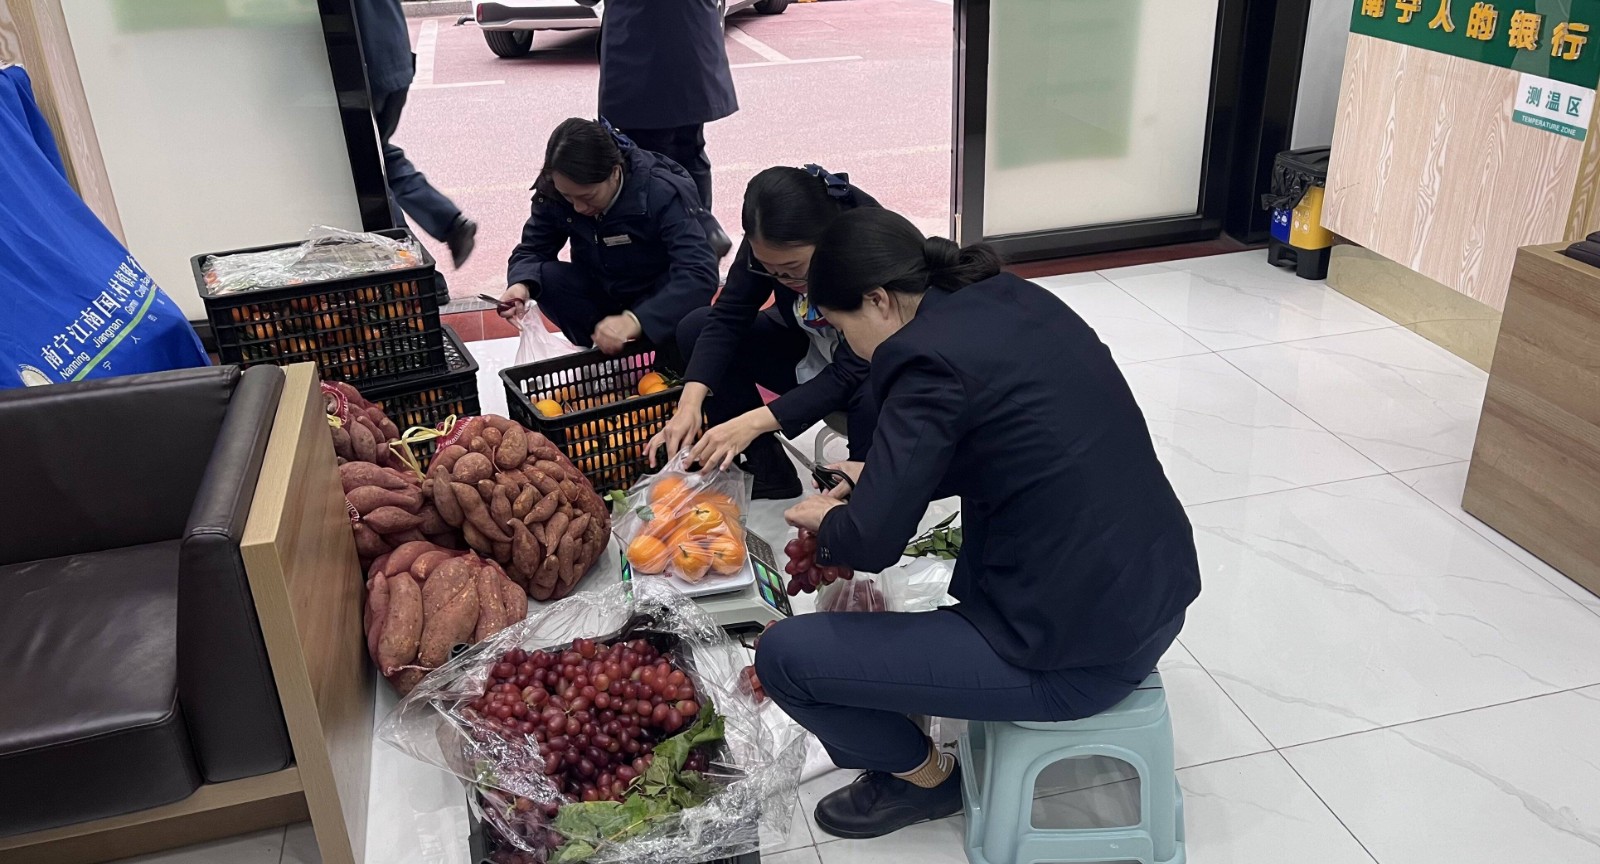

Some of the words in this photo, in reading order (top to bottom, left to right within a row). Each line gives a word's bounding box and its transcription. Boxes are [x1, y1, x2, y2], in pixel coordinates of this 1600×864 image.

[1526, 85, 1582, 117] 测温区
[1522, 115, 1560, 131] TEMPERATURE
[1561, 126, 1577, 136] ZONE
[60, 351, 91, 380] Nanning
[93, 318, 124, 348] Jiangnan
